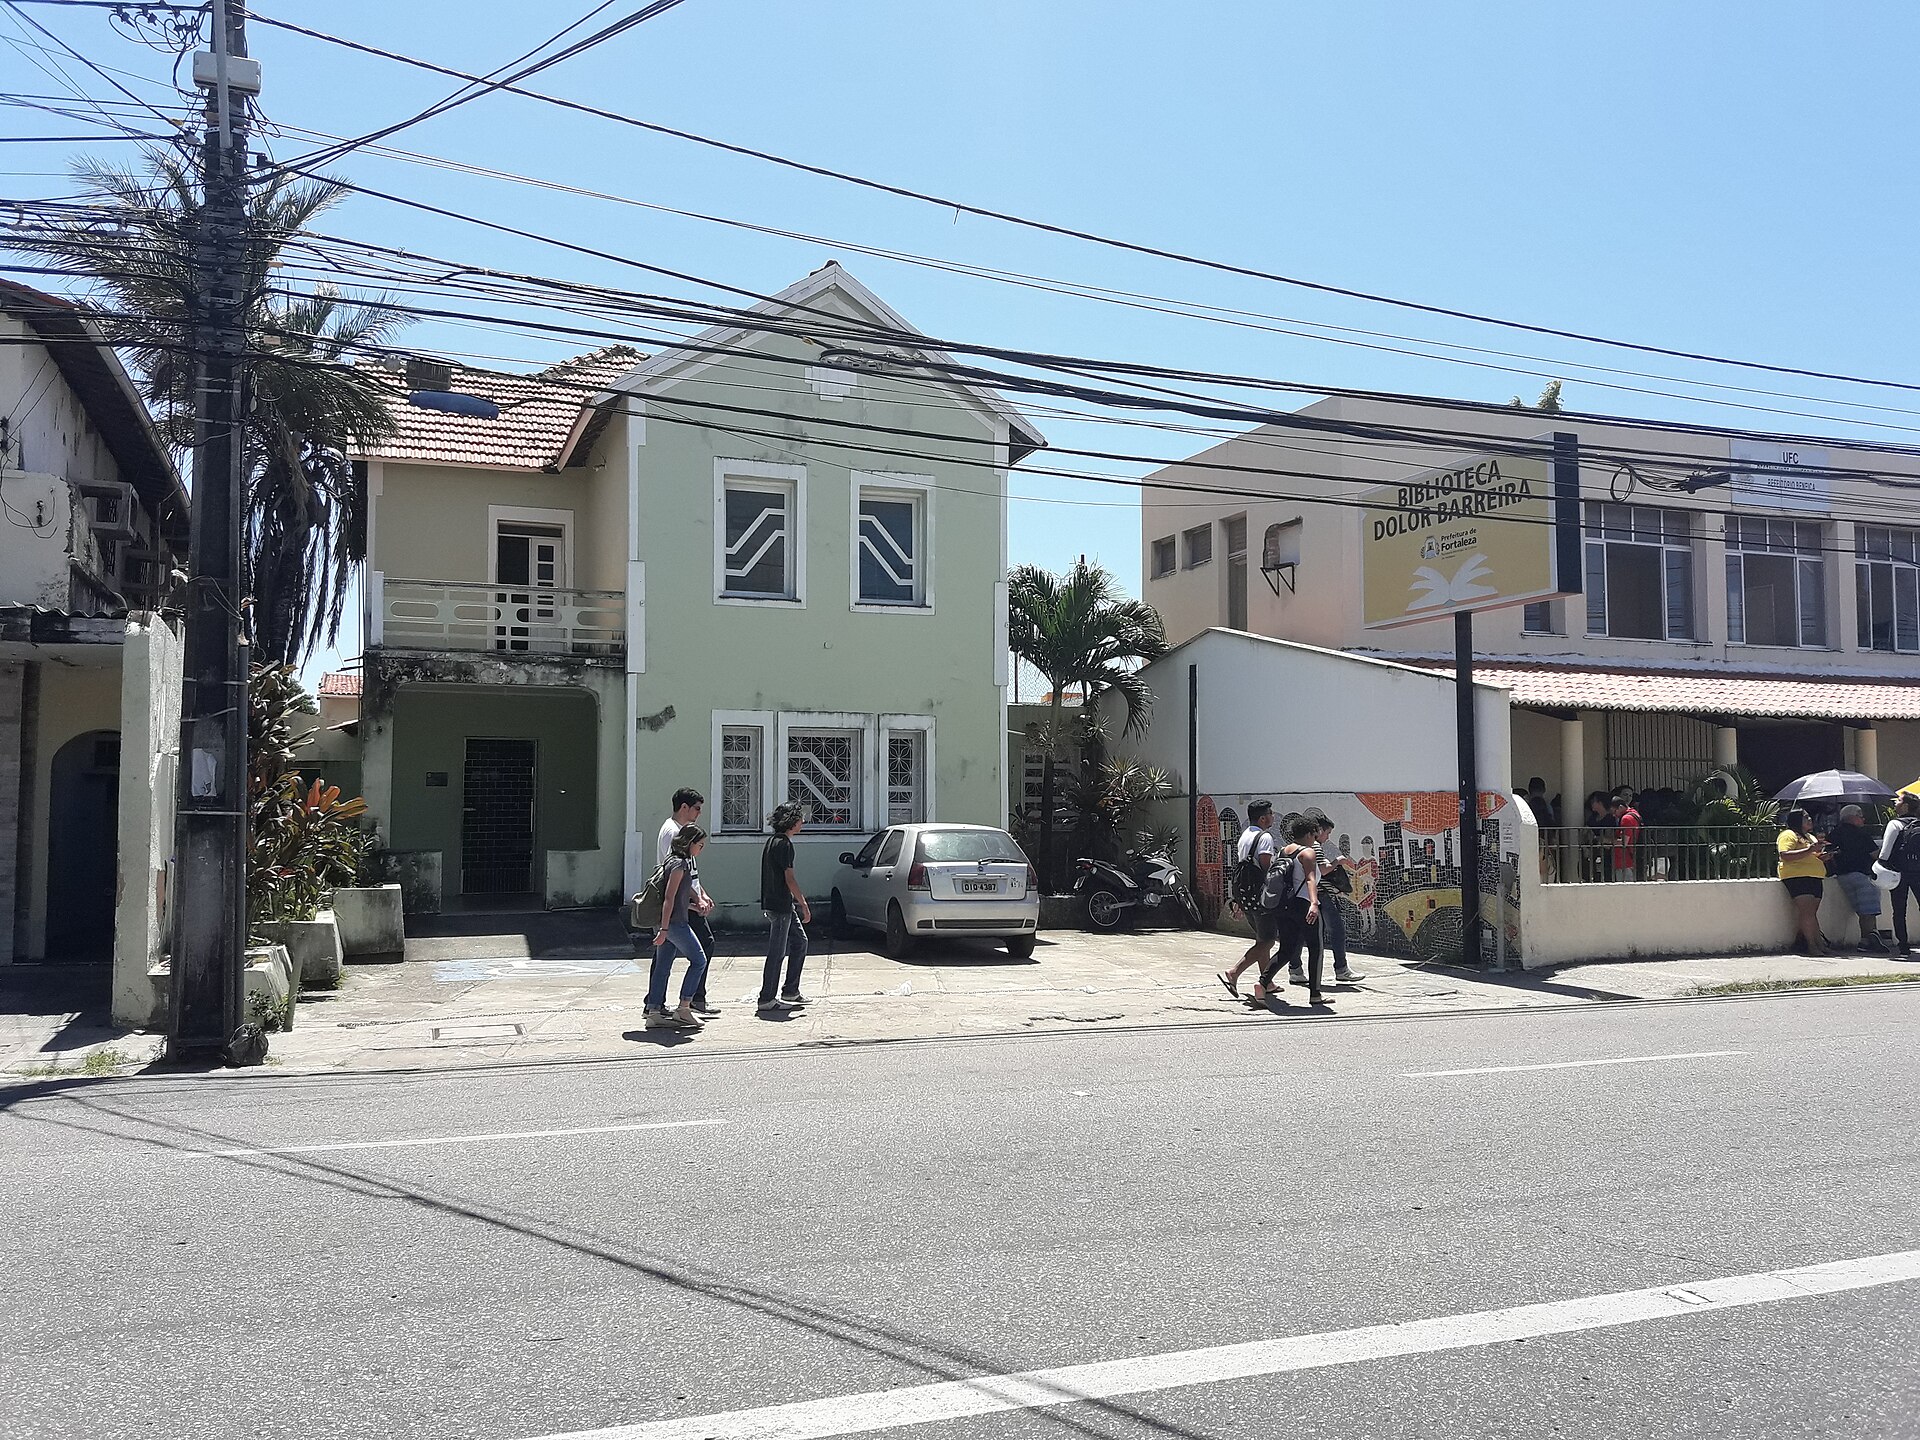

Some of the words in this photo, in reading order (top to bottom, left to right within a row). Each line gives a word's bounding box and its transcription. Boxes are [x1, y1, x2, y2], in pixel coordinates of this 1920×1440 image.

[1782, 451, 1799, 464] UFC
[1398, 459, 1500, 507] BIBLIOTECA
[1374, 506, 1431, 541] DOLOR
[1437, 479, 1532, 524] BARREIRA
[1441, 530, 1468, 541] Prefeitura
[1469, 527, 1477, 535] de
[1441, 536, 1477, 551] Fortaleza
